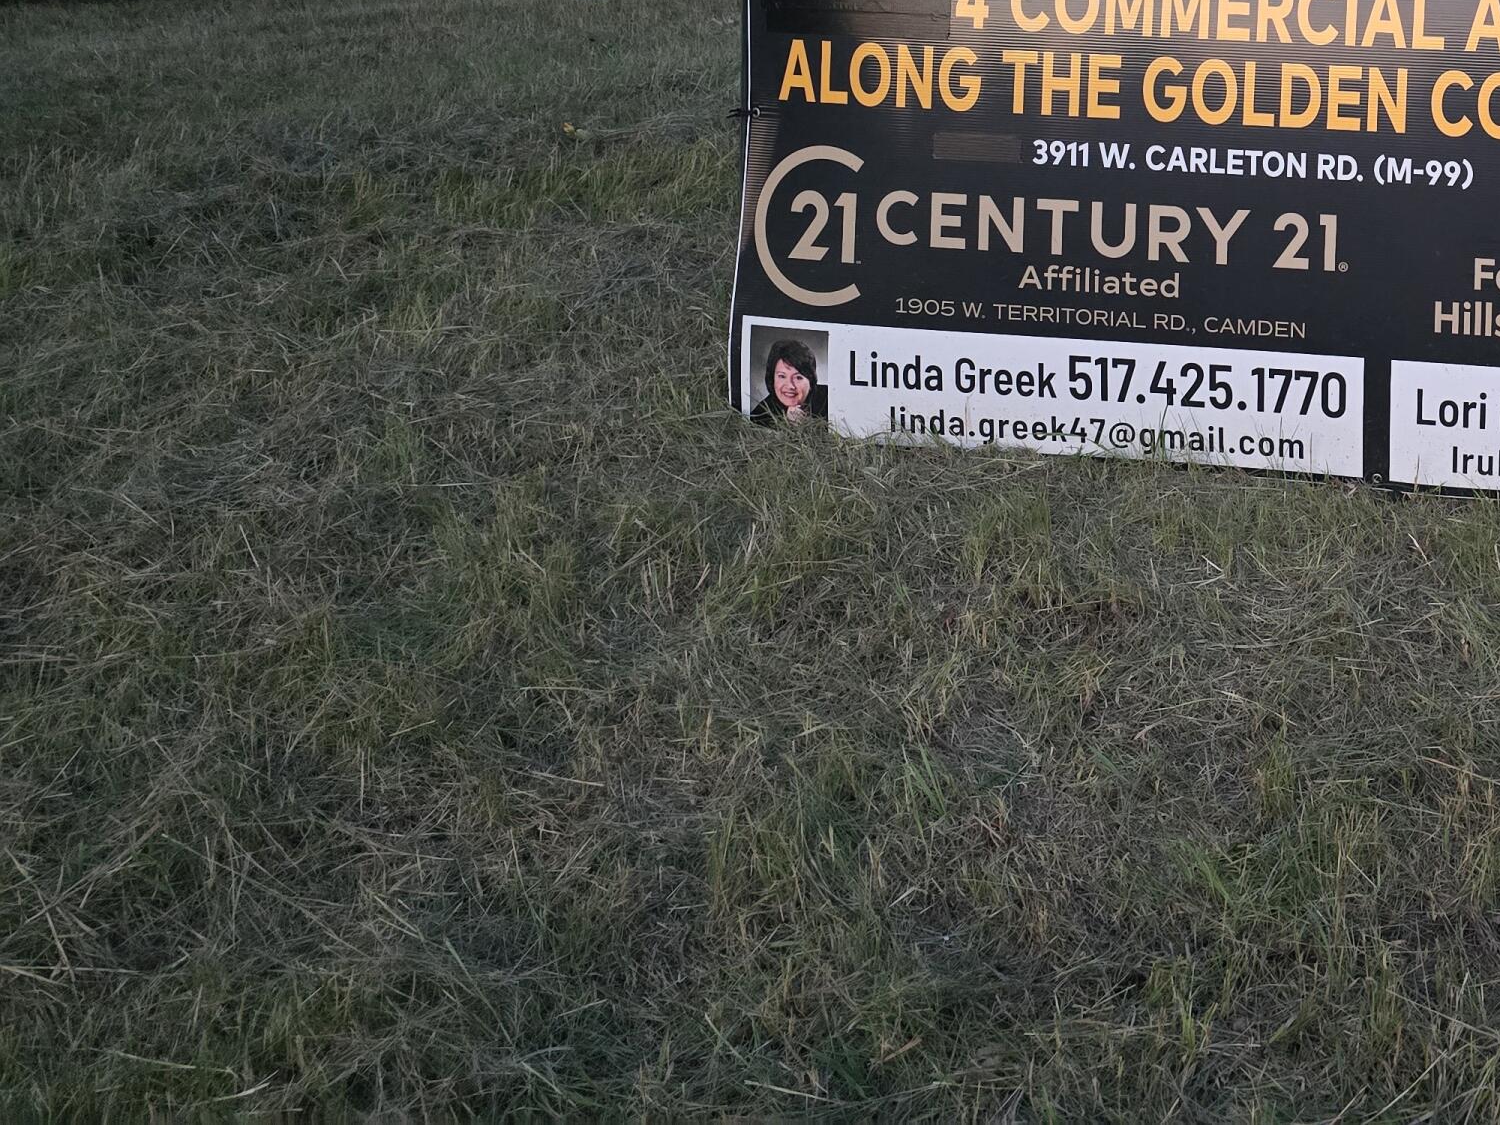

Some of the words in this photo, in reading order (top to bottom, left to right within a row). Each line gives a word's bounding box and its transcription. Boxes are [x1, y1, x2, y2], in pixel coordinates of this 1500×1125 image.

[778, 39, 982, 112] ALONG
[1002, 50, 1122, 119] THE
[1143, 56, 1408, 134] GOLDEN
[1032, 139, 1090, 168] 3911
[1099, 142, 1136, 170] W.
[1145, 144, 1308, 179] CARLETON
[1317, 153, 1364, 182] RD.
[1373, 156, 1474, 190] (M-99)
[876, 190, 1252, 266] CENTURY
[1018, 264, 1180, 299] Affiliated
[895, 297, 955, 317] 1905
[962, 302, 985, 318] W.
[993, 303, 1147, 329] TERRITORIAL
[1153, 313, 1197, 334] RD.,
[1203, 317, 1307, 339] CAMDEN
[849, 349, 945, 392] Linda
[954, 356, 1057, 399] Greek
[1068, 354, 1347, 419] 517.425.1770
[1415, 388, 1488, 430] Lori
[890, 405, 1304, 460] linda.greek47@gmail.com
